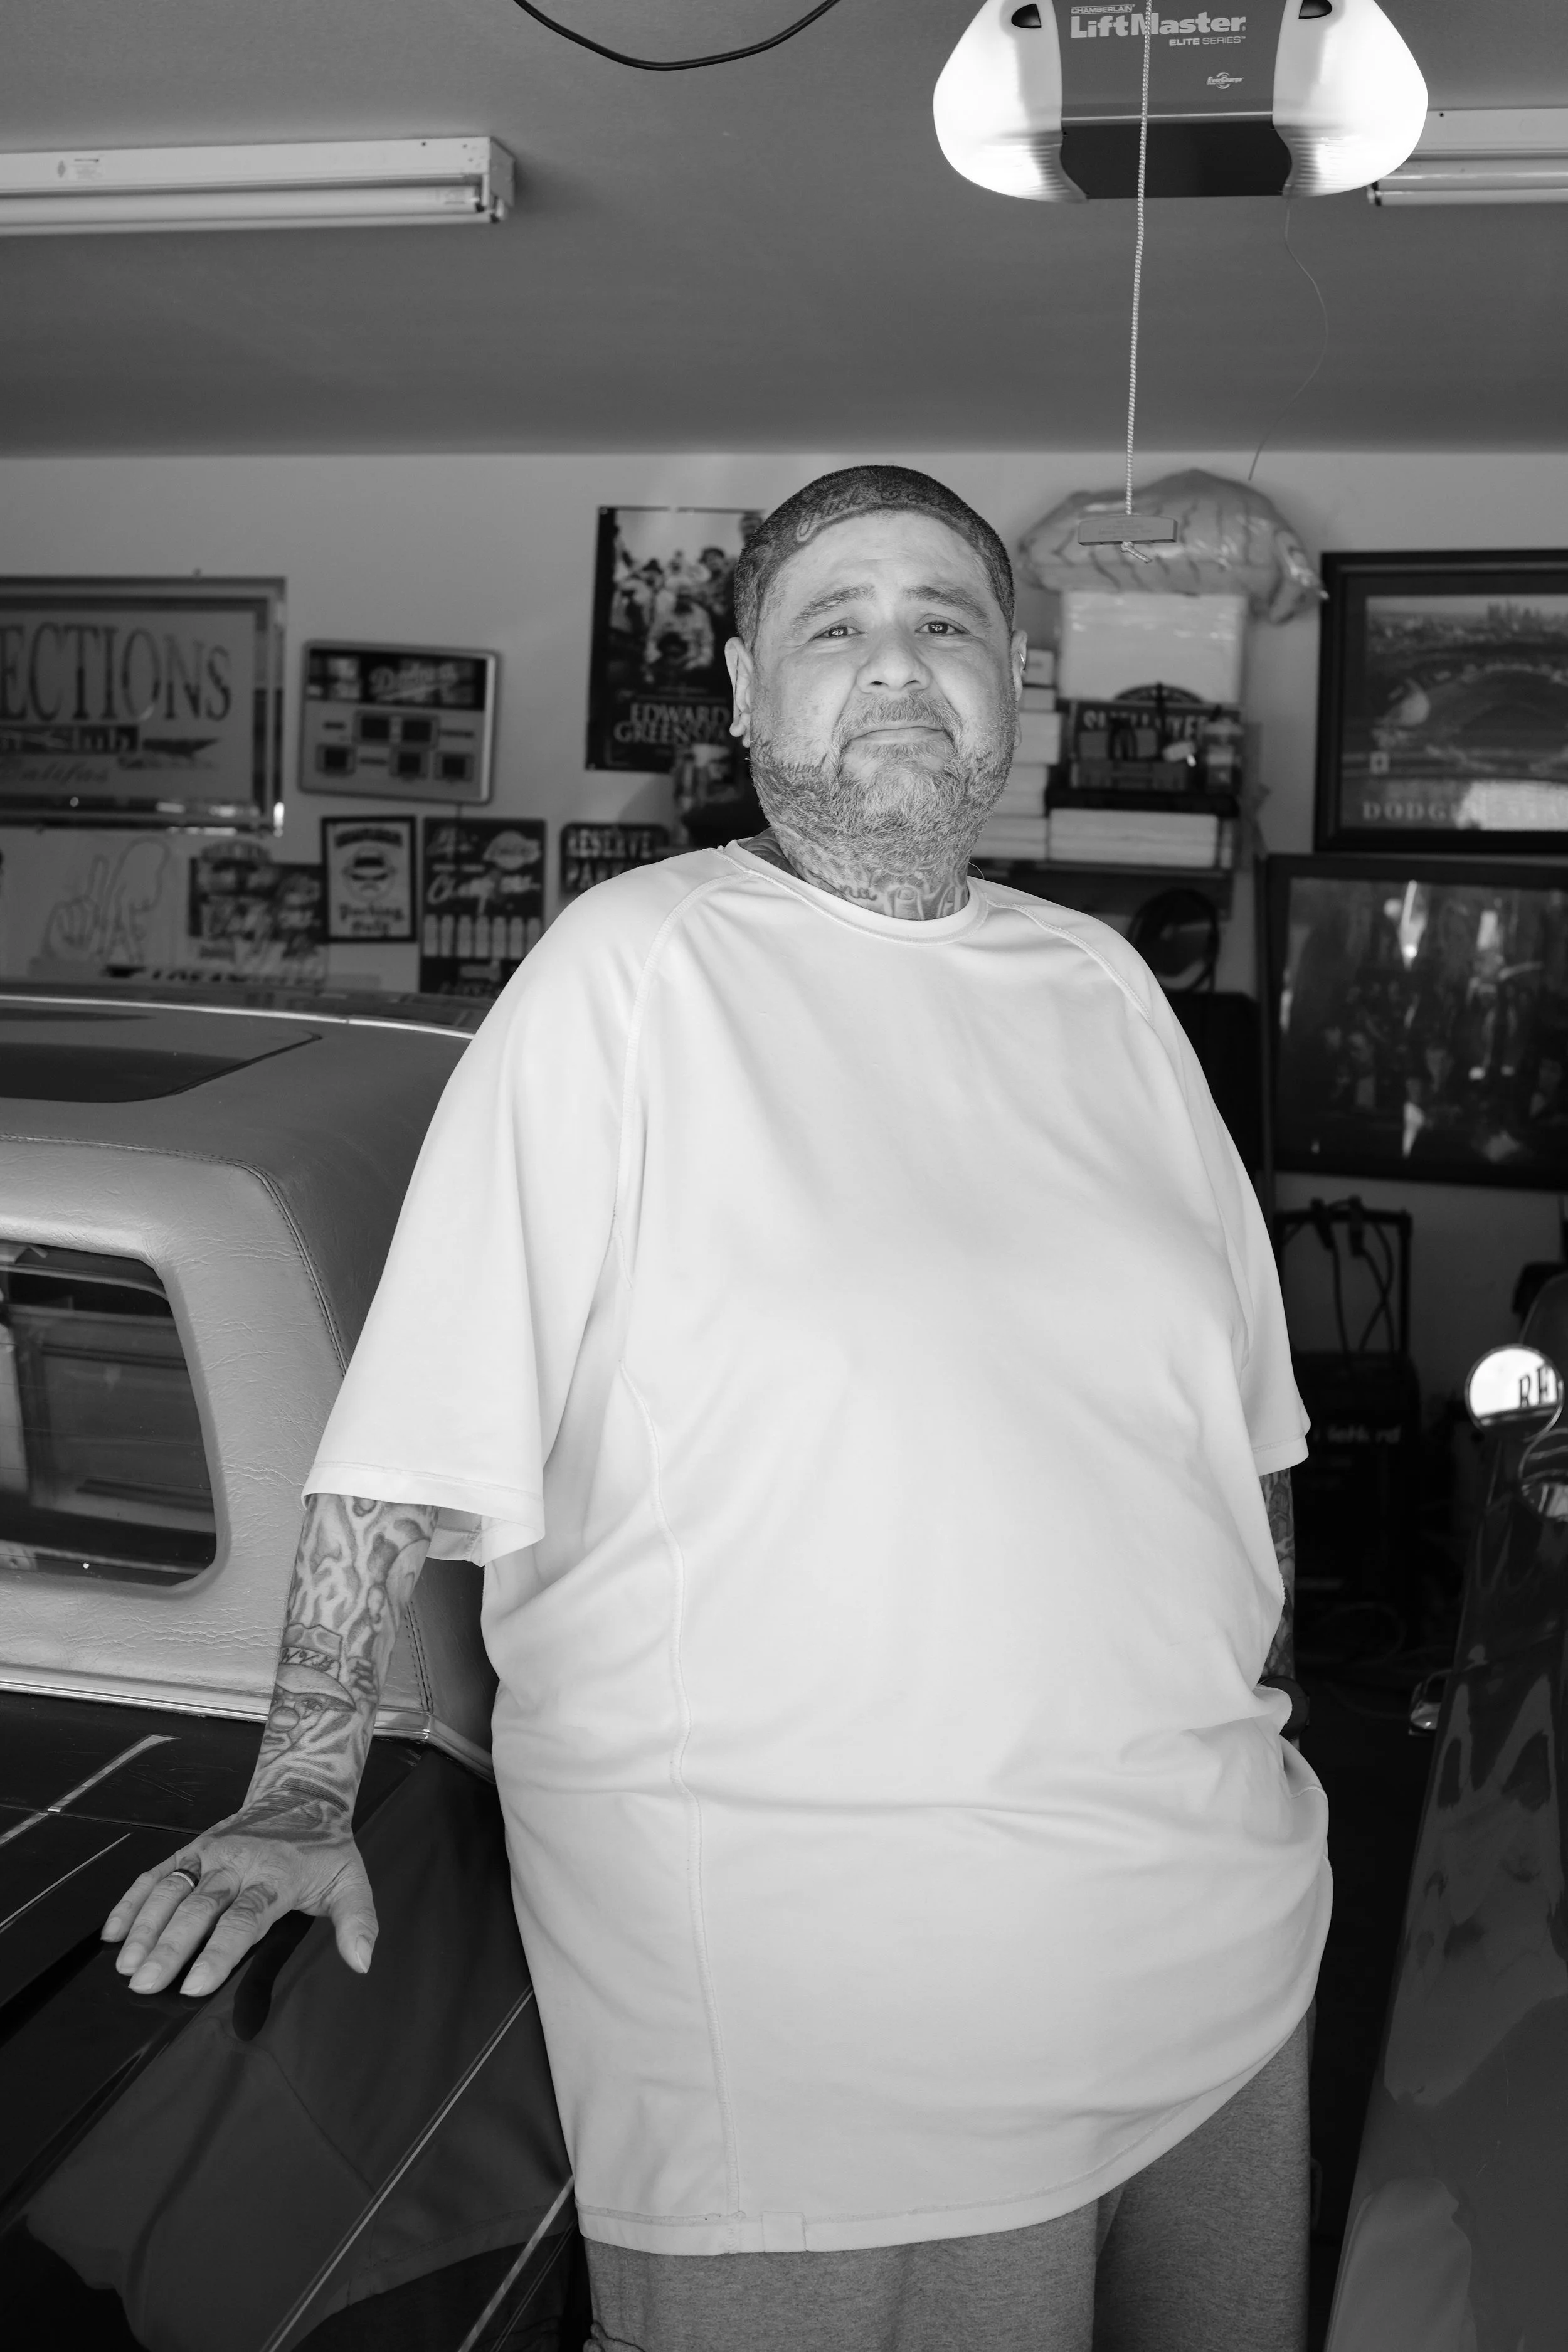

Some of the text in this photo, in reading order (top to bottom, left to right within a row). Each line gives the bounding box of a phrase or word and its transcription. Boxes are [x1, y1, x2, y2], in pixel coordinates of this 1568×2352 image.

[1071, 6, 1133, 14] CHAMBERLAIN
[1070, 11, 1246, 38] LiftMaster
[1169, 36, 1242, 46] ELITE SERIES
[629, 702, 729, 724] EDWARD
[566, 827, 662, 859] RESERVE
